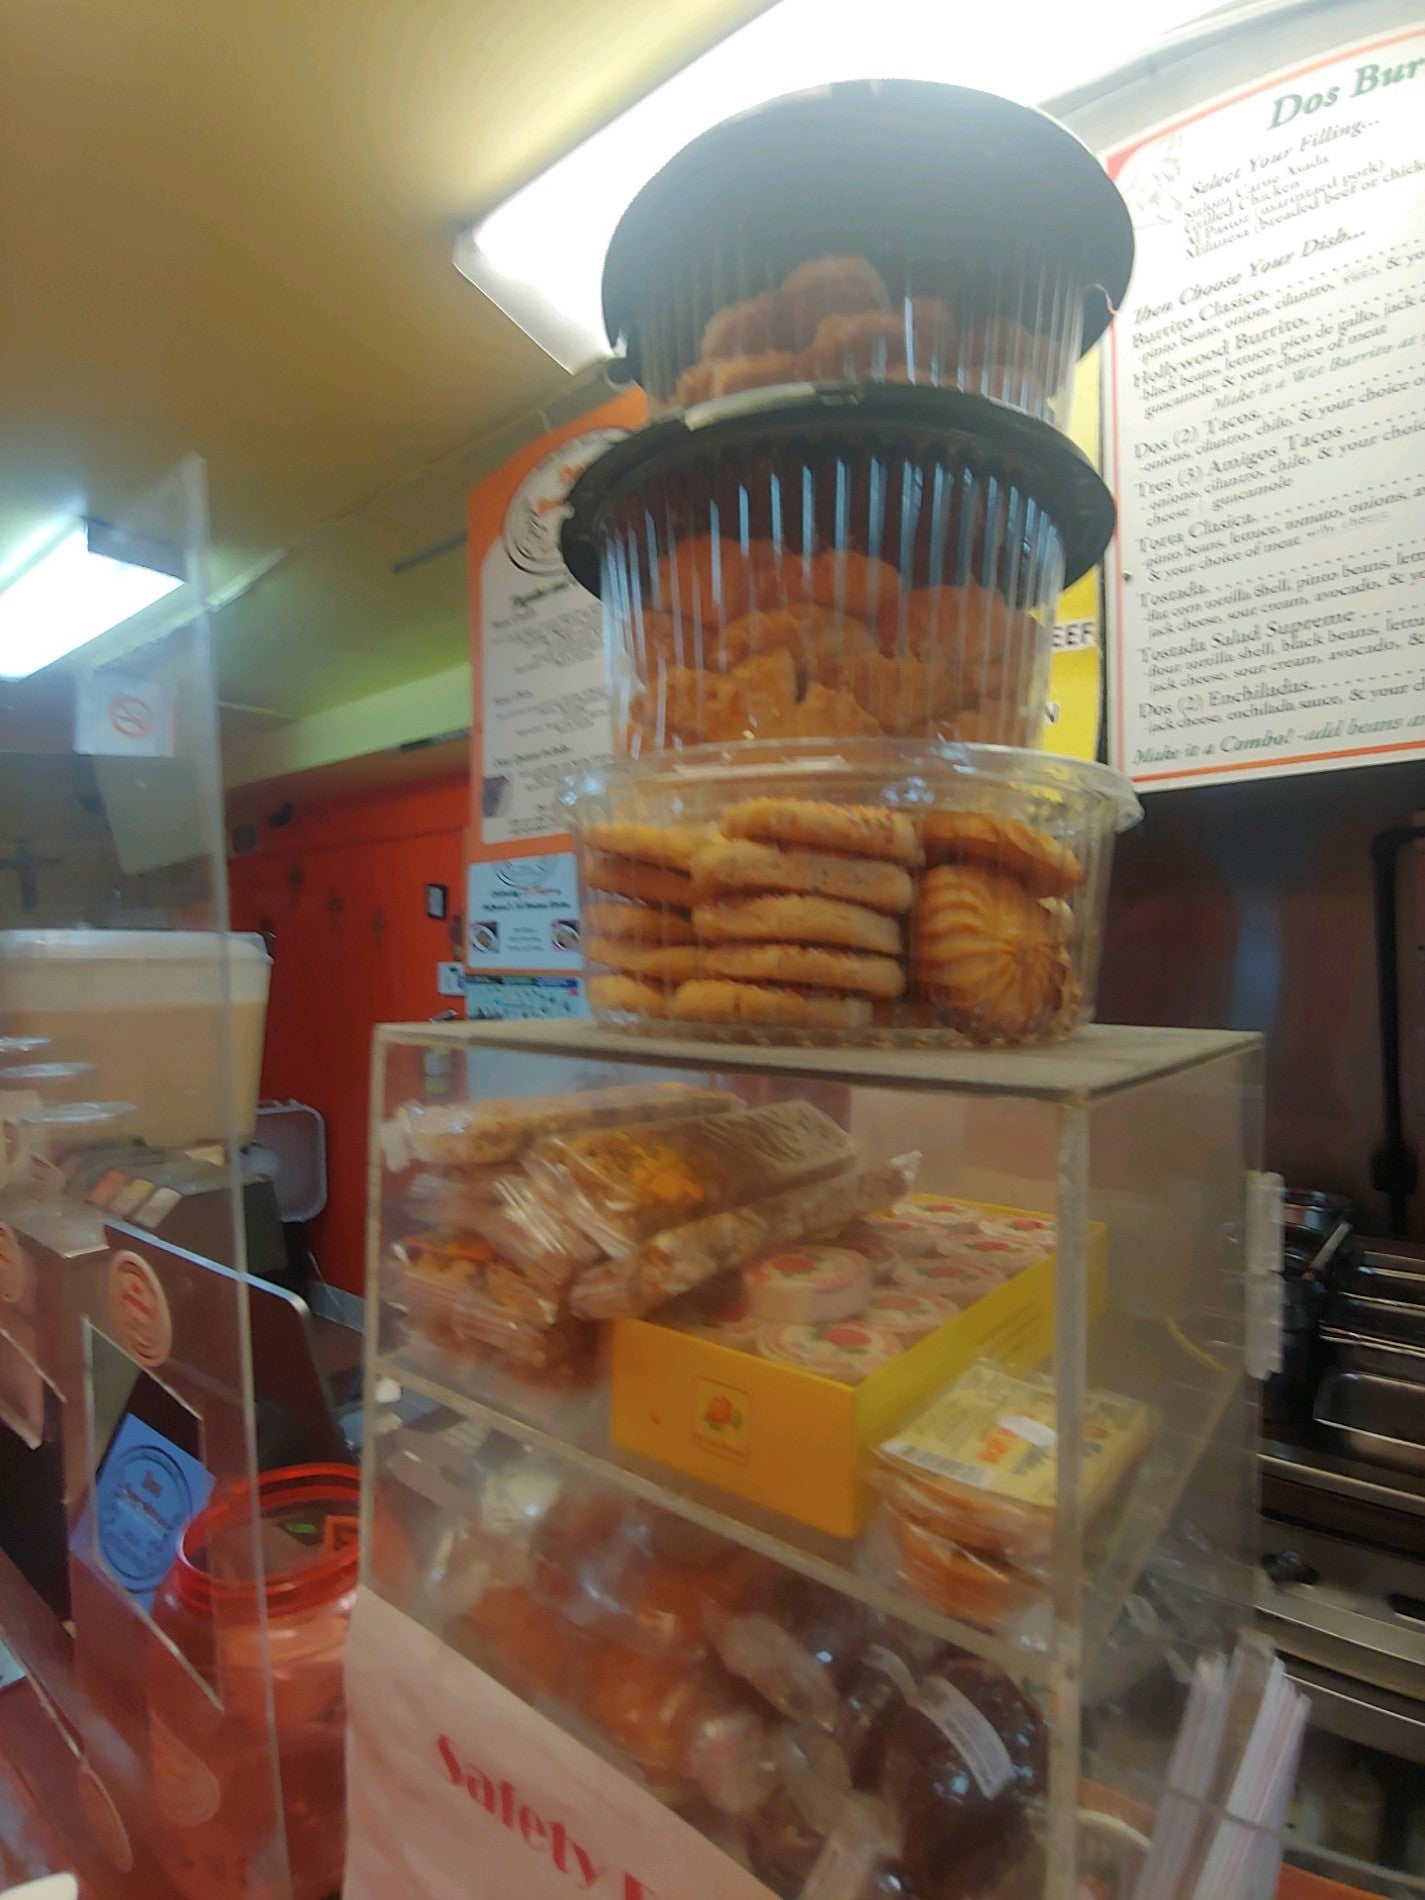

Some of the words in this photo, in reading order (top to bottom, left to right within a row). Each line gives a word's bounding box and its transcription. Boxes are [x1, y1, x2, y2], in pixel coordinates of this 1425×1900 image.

[1266, 85, 1340, 130] Dos
[1190, 167, 1241, 198] Select
[1250, 148, 1294, 172] Your
[1324, 182, 1356, 206] beef
[1361, 178, 1378, 191] or
[1343, 160, 1385, 187] pork)
[1386, 255, 1401, 269] &
[1134, 302, 1174, 325] Then
[1179, 273, 1242, 305] Choose
[1250, 252, 1296, 278] Your
[1132, 317, 1194, 349] Burrito
[1280, 333, 1312, 358] pico
[1315, 323, 1334, 339] de
[1384, 295, 1417, 318] jack
[1132, 338, 1230, 388] Hollywood
[1221, 376, 1235, 388] &
[1239, 364, 1273, 384] your
[1276, 346, 1325, 369] choice
[1327, 337, 1344, 352] of
[1348, 324, 1388, 344] meat
[1329, 344, 1393, 372] Burrito
[1298, 410, 1312, 422] &
[1318, 398, 1355, 419] your
[1358, 380, 1410, 403] choice
[1134, 439, 1170, 460] Dos
[1173, 424, 1199, 449] (2)
[1136, 478, 1173, 498] Tres
[1177, 465, 1202, 488] (3)
[1208, 447, 1279, 475] Amigos
[1284, 427, 1343, 451] Tacos
[1317, 447, 1333, 460] &
[1339, 435, 1378, 457] your
[1146, 508, 1190, 527] cheese
[1212, 477, 1294, 511] guacamole
[1135, 533, 1185, 553] Torta
[1148, 569, 1161, 582] &
[1164, 563, 1198, 580] your
[1199, 551, 1242, 570] choice
[1245, 542, 1262, 558] of
[1263, 536, 1301, 552] meat
[1149, 622, 1176, 639] jack
[1227, 607, 1259, 620] sour
[1388, 572, 1405, 585] &
[1170, 603, 1203, 618] corn
[1204, 588, 1253, 609] tortilla
[1296, 572, 1339, 592] pinto
[1136, 637, 1207, 664] Tostada
[1211, 624, 1261, 649] Salad
[1265, 610, 1355, 637] Supreme
[1185, 651, 1235, 670] tortilla
[1281, 631, 1324, 651] black
[1149, 677, 1177, 695] jack
[1233, 664, 1267, 677] sour
[1407, 632, 1424, 646] &
[1139, 702, 1172, 718] Dos
[1177, 693, 1203, 714] (2)
[1226, 701, 1296, 721] enchilada
[1348, 688, 1366, 701] &
[1371, 684, 1409, 701] your
[1133, 744, 1180, 765] Make
[1184, 743, 1199, 757] it
[1203, 744, 1216, 755] a
[1220, 728, 1294, 752] Combo!
[1346, 718, 1403, 736] beans
[438, 1734, 606, 1890] Safety
